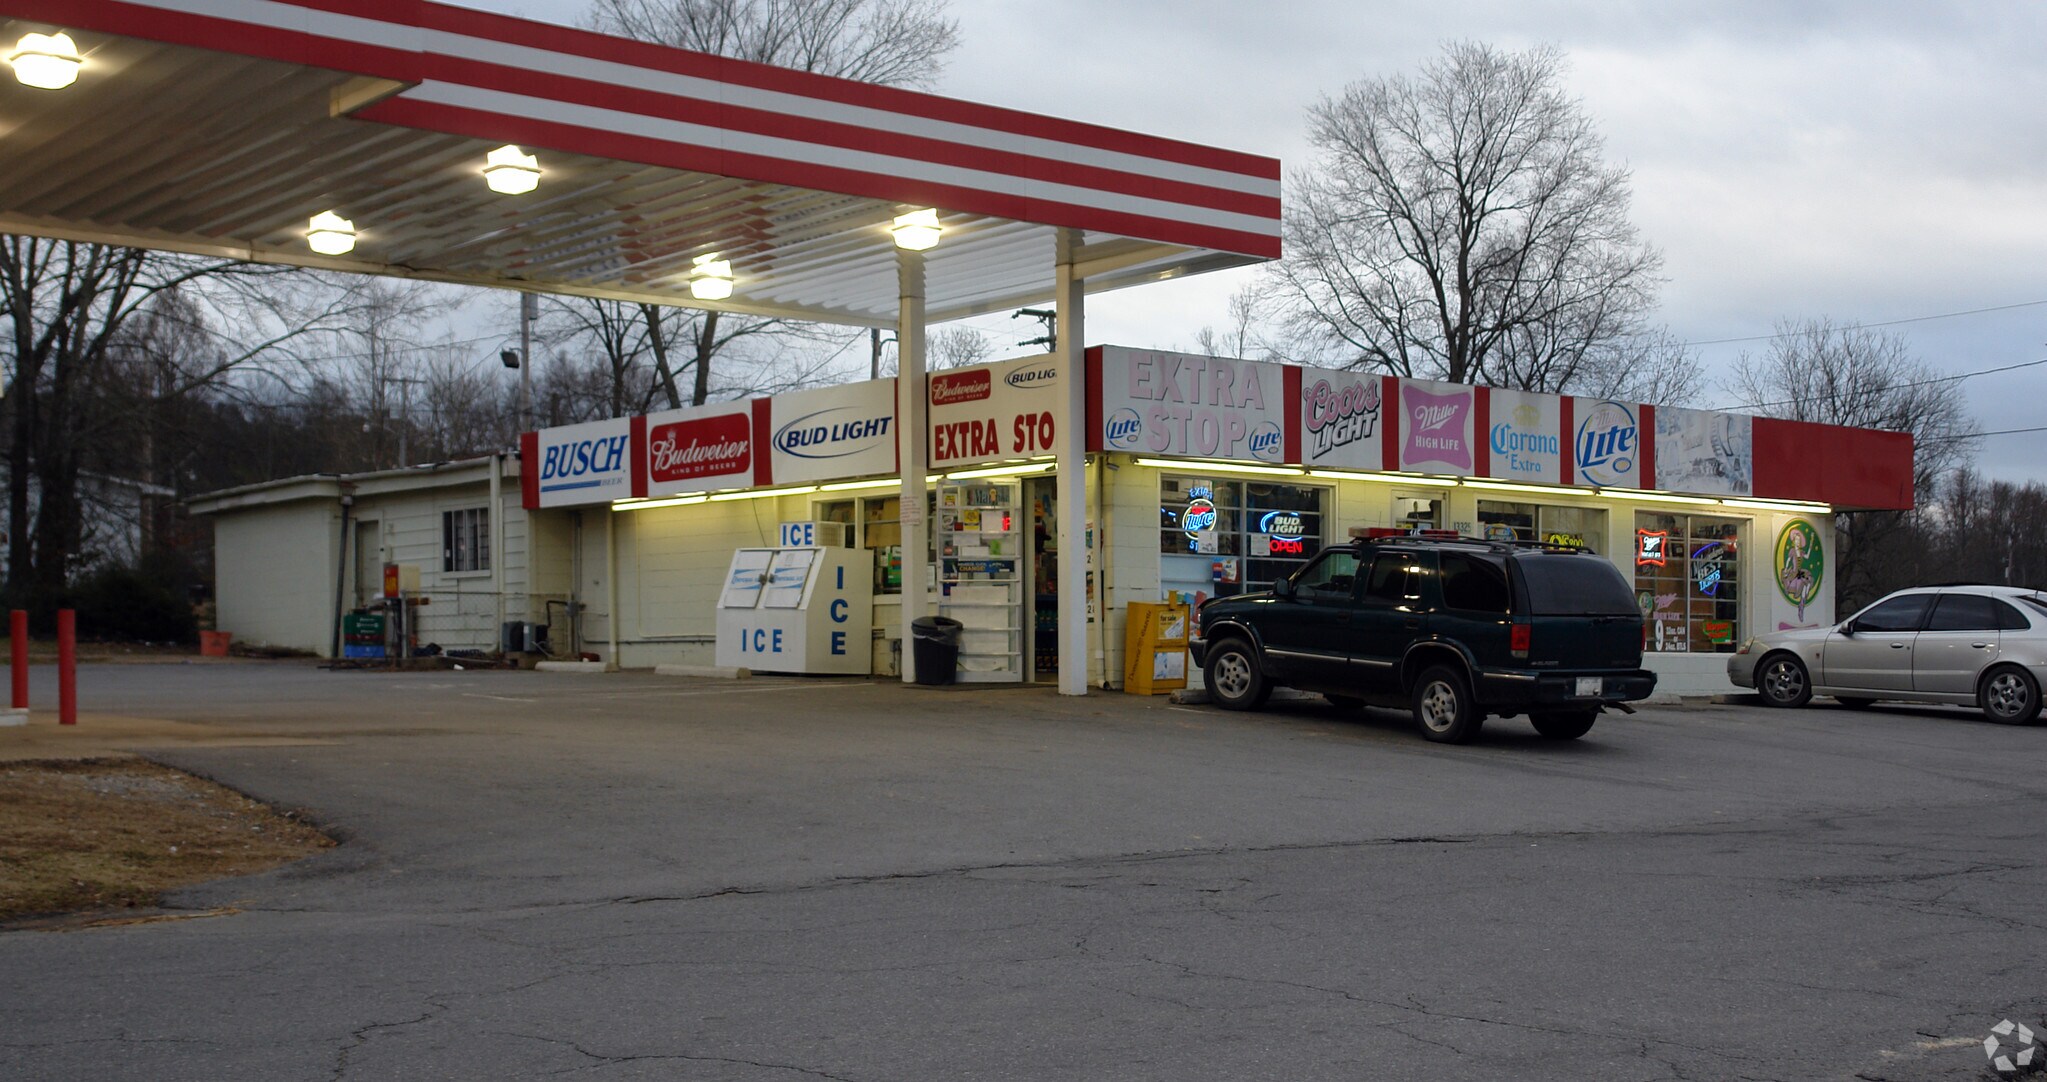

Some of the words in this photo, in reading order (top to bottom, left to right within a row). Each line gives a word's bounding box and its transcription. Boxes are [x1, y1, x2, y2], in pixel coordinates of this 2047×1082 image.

[933, 379, 989, 401] Budweiser
[1012, 371, 1035, 385] BUD
[1129, 354, 1265, 411] EXTRA
[1303, 379, 1381, 432] Coors
[1415, 404, 1459, 432] Miller
[786, 427, 828, 449] BUD
[831, 416, 893, 442] LIGHT
[934, 418, 999, 461] EXTRA
[1109, 417, 1141, 440] Lite
[1146, 405, 1246, 457] STOP
[1251, 430, 1281, 452] Lite
[1312, 411, 1378, 460] LIGHT
[1490, 422, 1559, 459] Corona
[651, 435, 748, 471] Budweiser
[1415, 435, 1439, 449] HIGH
[1440, 437, 1459, 451] LIFE
[1581, 425, 1637, 470] Lite
[540, 435, 629, 480] BUSCH
[671, 467, 690, 475] KING
[709, 462, 736, 471] BEERS
[1510, 453, 1542, 472] Extra
[600, 477, 623, 486] BEER
[1189, 486, 1213, 501] EXTRA
[1269, 524, 1305, 534] LIGHT
[1274, 516, 1299, 526] BUD
[782, 524, 813, 546] ICE
[1270, 540, 1303, 553] OPEN
[829, 566, 849, 655] ICE
[742, 628, 782, 653] ICE
[1655, 619, 1664, 652] 9
